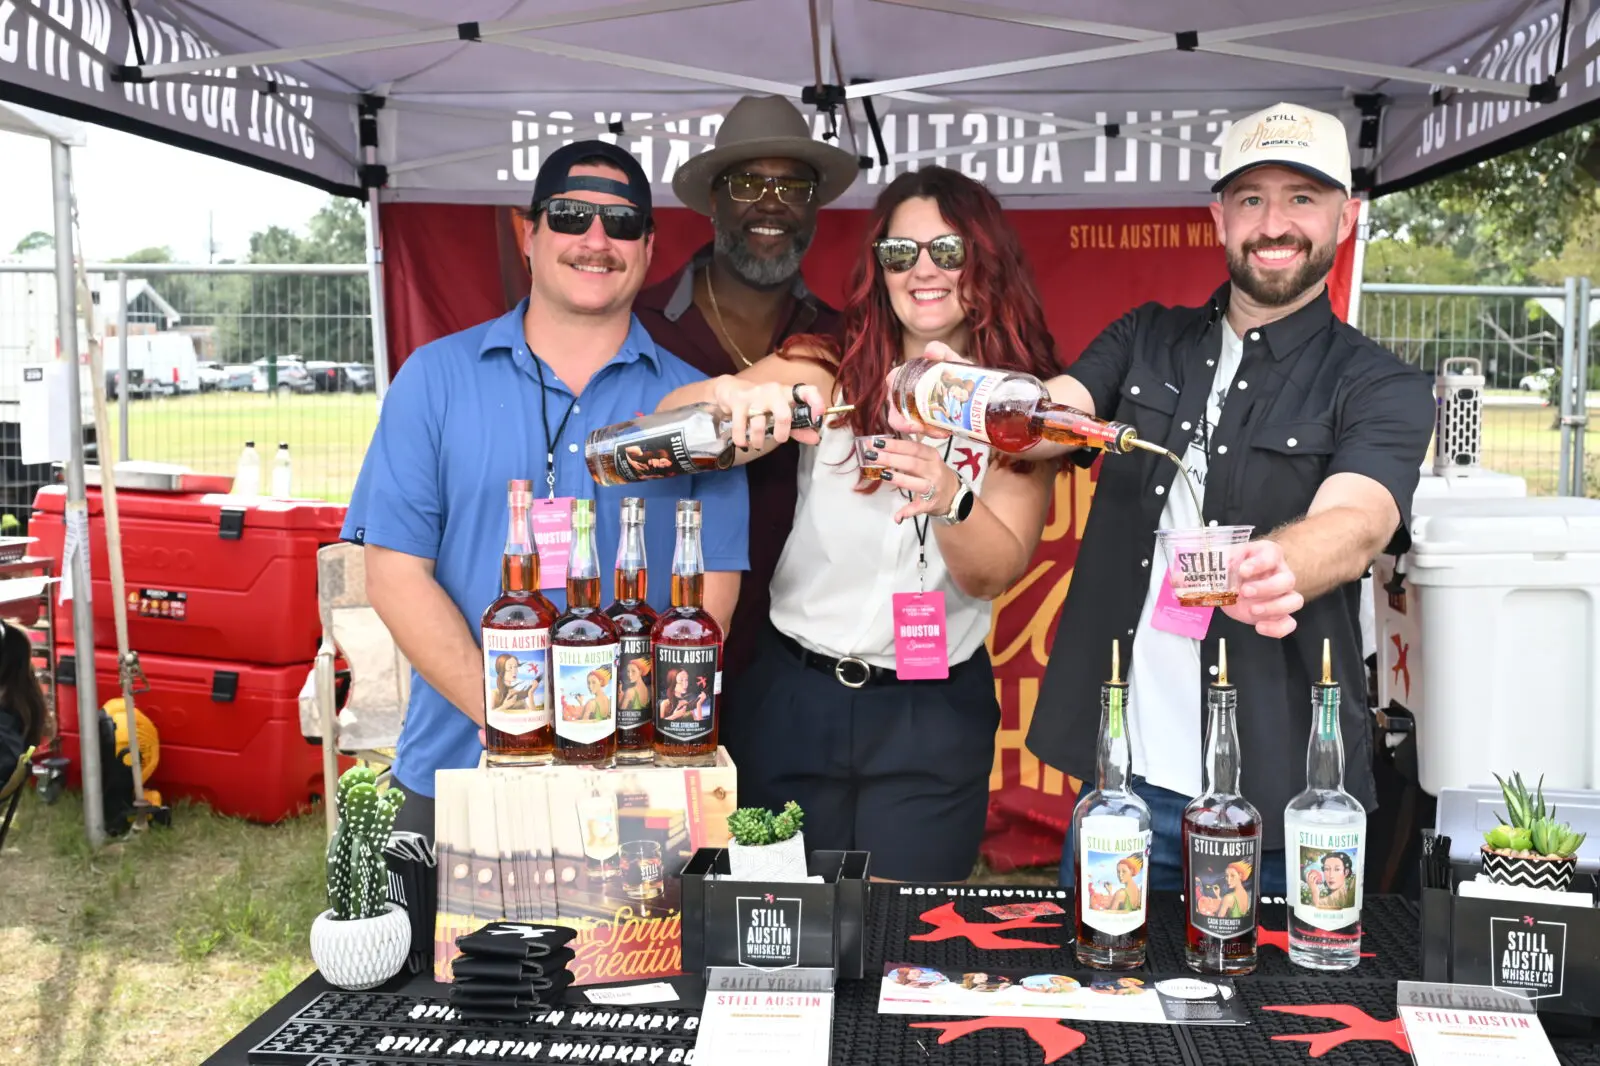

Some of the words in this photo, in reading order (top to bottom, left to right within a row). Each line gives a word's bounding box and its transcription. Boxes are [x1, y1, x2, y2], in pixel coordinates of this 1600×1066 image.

[1266, 114, 1298, 122] STILL
[1070, 225, 1115, 249] STILL
[1120, 224, 1180, 249] AUSTIN
[972, 400, 984, 433] AUSTIN
[671, 435, 687, 461] STILL
[1178, 551, 1226, 573] STILL
[1183, 573, 1226, 582] AUSTIN
[900, 624, 941, 638] HOUSTON
[487, 634, 509, 649] STILL
[511, 634, 547, 649] AUSTIN
[559, 651, 582, 665] STILL
[584, 650, 613, 664] AUSTIN
[659, 649, 681, 663] STILL
[683, 649, 714, 664] AUSTIN
[1087, 836, 1111, 851] STILL
[1114, 835, 1145, 852] AUSTIN
[1194, 838, 1220, 856] STILL
[1222, 841, 1254, 857] AUSTIN
[1299, 831, 1325, 848] STILL
[1328, 832, 1359, 848] AUSTIN
[900, 886, 1067, 899] STILLAUSTIN.COM
[752, 908, 787, 928] STILL
[1219, 918, 1241, 926] STRENGTH
[746, 926, 791, 945] AUSTIN
[1507, 930, 1549, 954] STILL
[746, 944, 780, 955] WHISKEY
[781, 945, 791, 956] CO
[1502, 950, 1554, 973] AUSTIN
[1502, 967, 1541, 983] WHISKEY
[1542, 972, 1554, 984] CO
[717, 995, 758, 1006] STILL
[765, 995, 821, 1007] AUSTIN
[1415, 1011, 1461, 1024] STILL
[1468, 1014, 1530, 1029] AUSTIN
[375, 1035, 445, 1053] STILL
